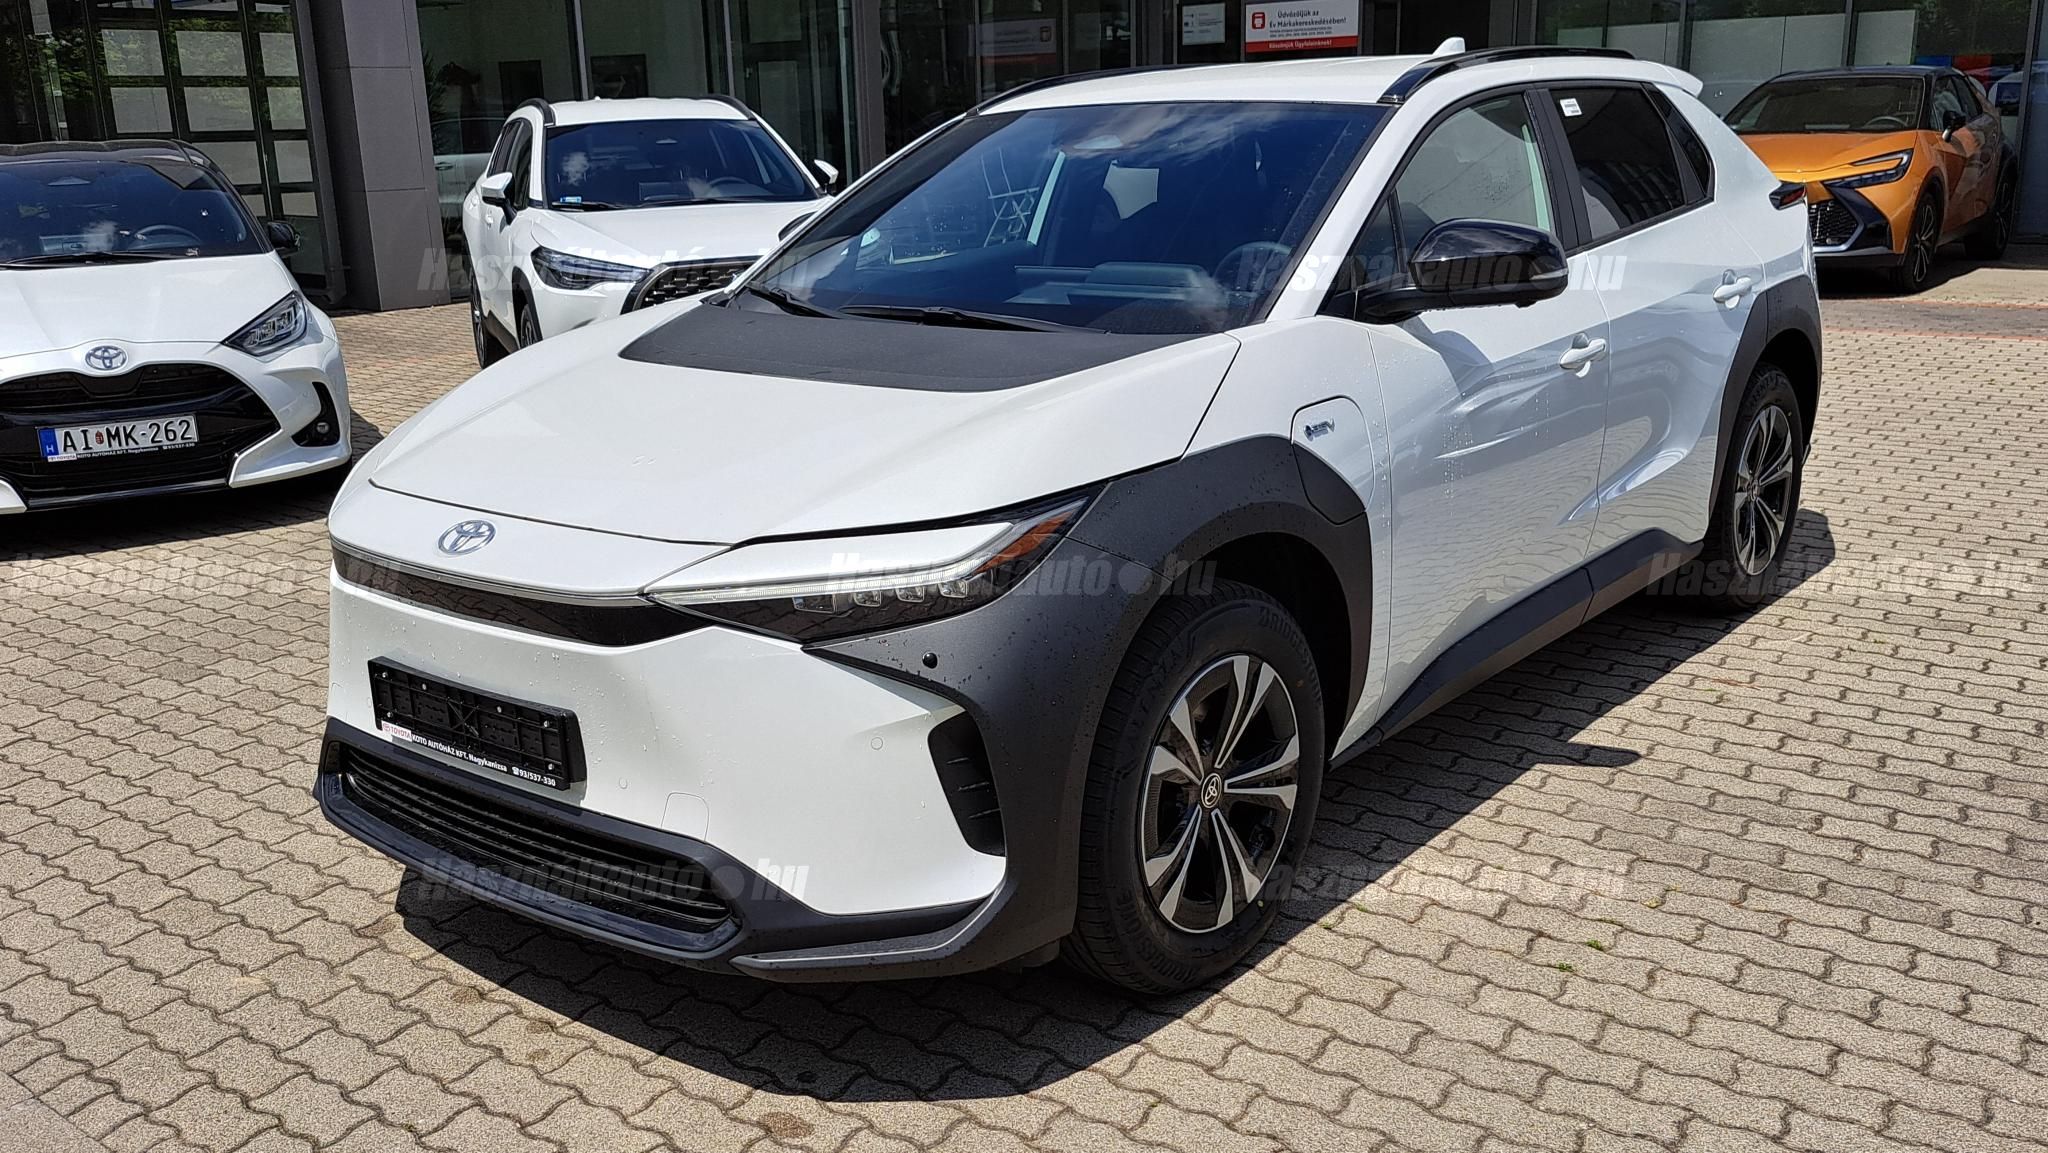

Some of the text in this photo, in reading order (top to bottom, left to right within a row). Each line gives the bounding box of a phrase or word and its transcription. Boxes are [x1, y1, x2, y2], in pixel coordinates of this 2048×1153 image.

[46, 444, 55, 454] H
[63, 419, 193, 453] AI MK-262
[390, 726, 556, 787] TOYOTA KOTO AUTÓHÁZ KFT. Nagykanizsa 93/537-330
